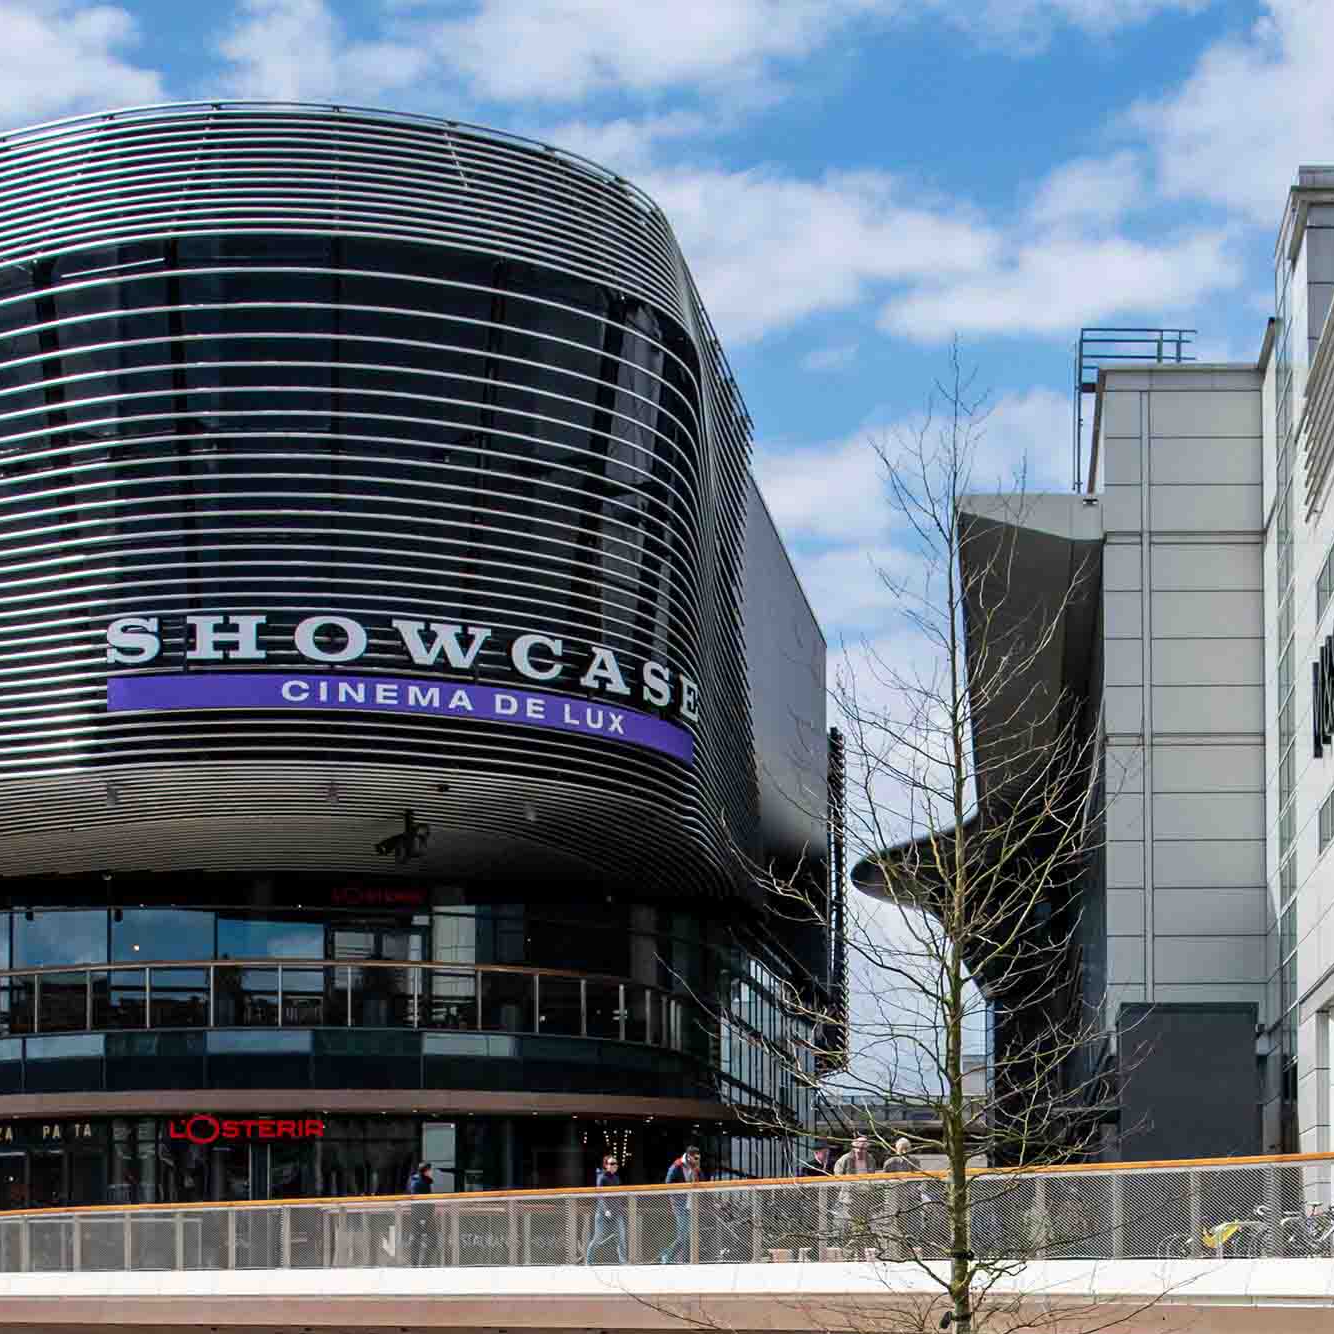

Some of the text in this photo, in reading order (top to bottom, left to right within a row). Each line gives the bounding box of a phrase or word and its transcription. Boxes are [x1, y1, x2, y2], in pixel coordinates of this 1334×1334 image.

[106, 614, 701, 723] SHOWCASE
[280, 679, 627, 736] CINEMA DE LUX
[42, 1123, 92, 1139] PATA
